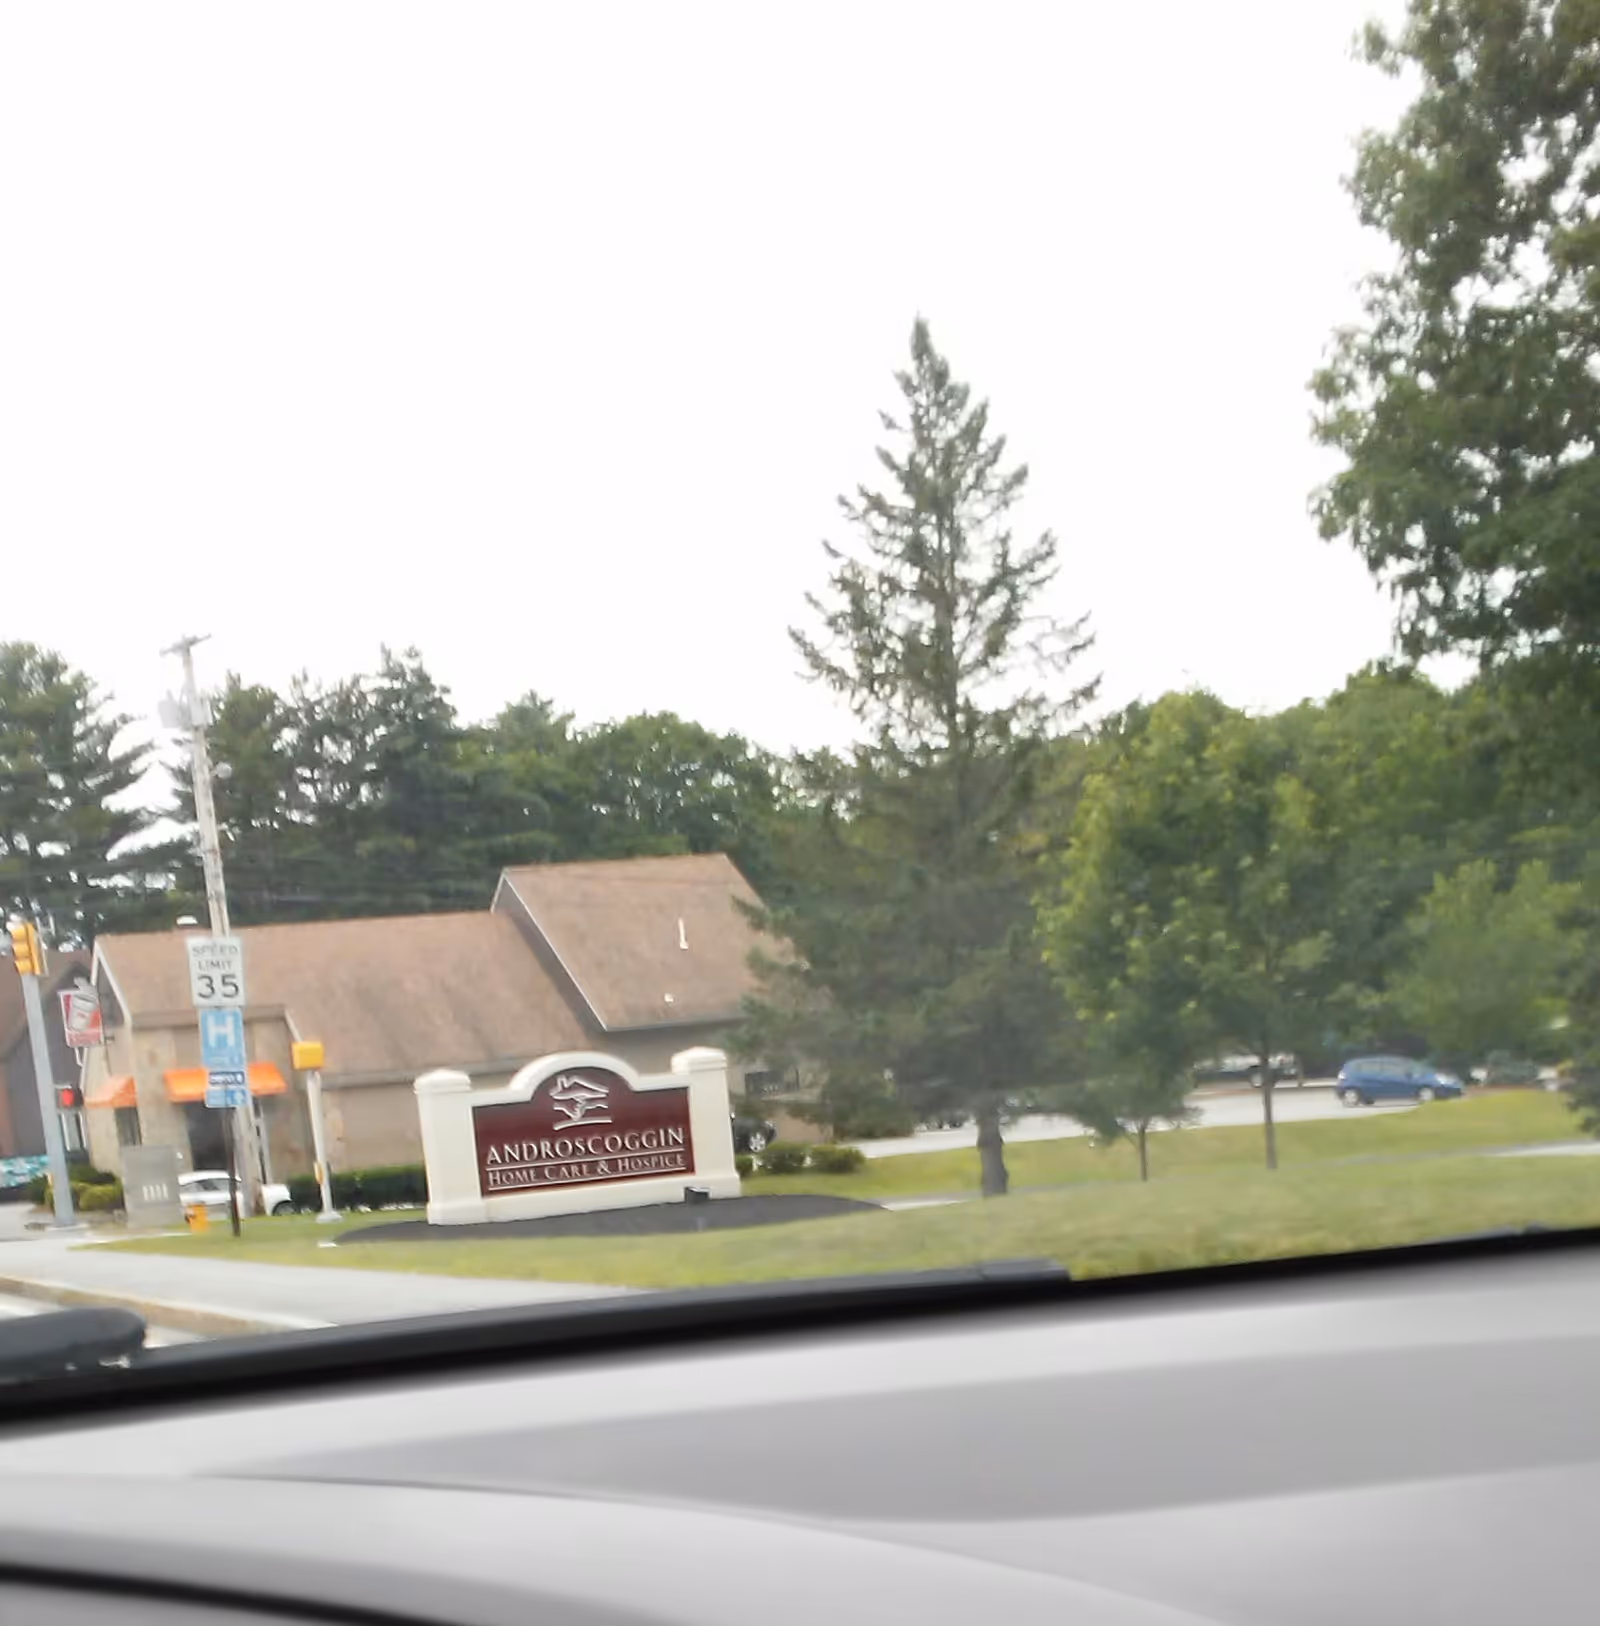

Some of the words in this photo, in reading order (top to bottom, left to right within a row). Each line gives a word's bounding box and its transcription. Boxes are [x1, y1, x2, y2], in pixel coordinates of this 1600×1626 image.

[192, 944, 238, 957] SPEED
[198, 960, 232, 971] LIMIT
[197, 973, 239, 999] 35
[207, 1015, 235, 1047] H
[486, 1127, 684, 1166] ANDROSCOGGIN
[488, 1168, 538, 1186] HOME
[544, 1163, 590, 1180] CARE
[597, 1161, 612, 1175] &
[618, 1154, 686, 1172] HOSPICE
